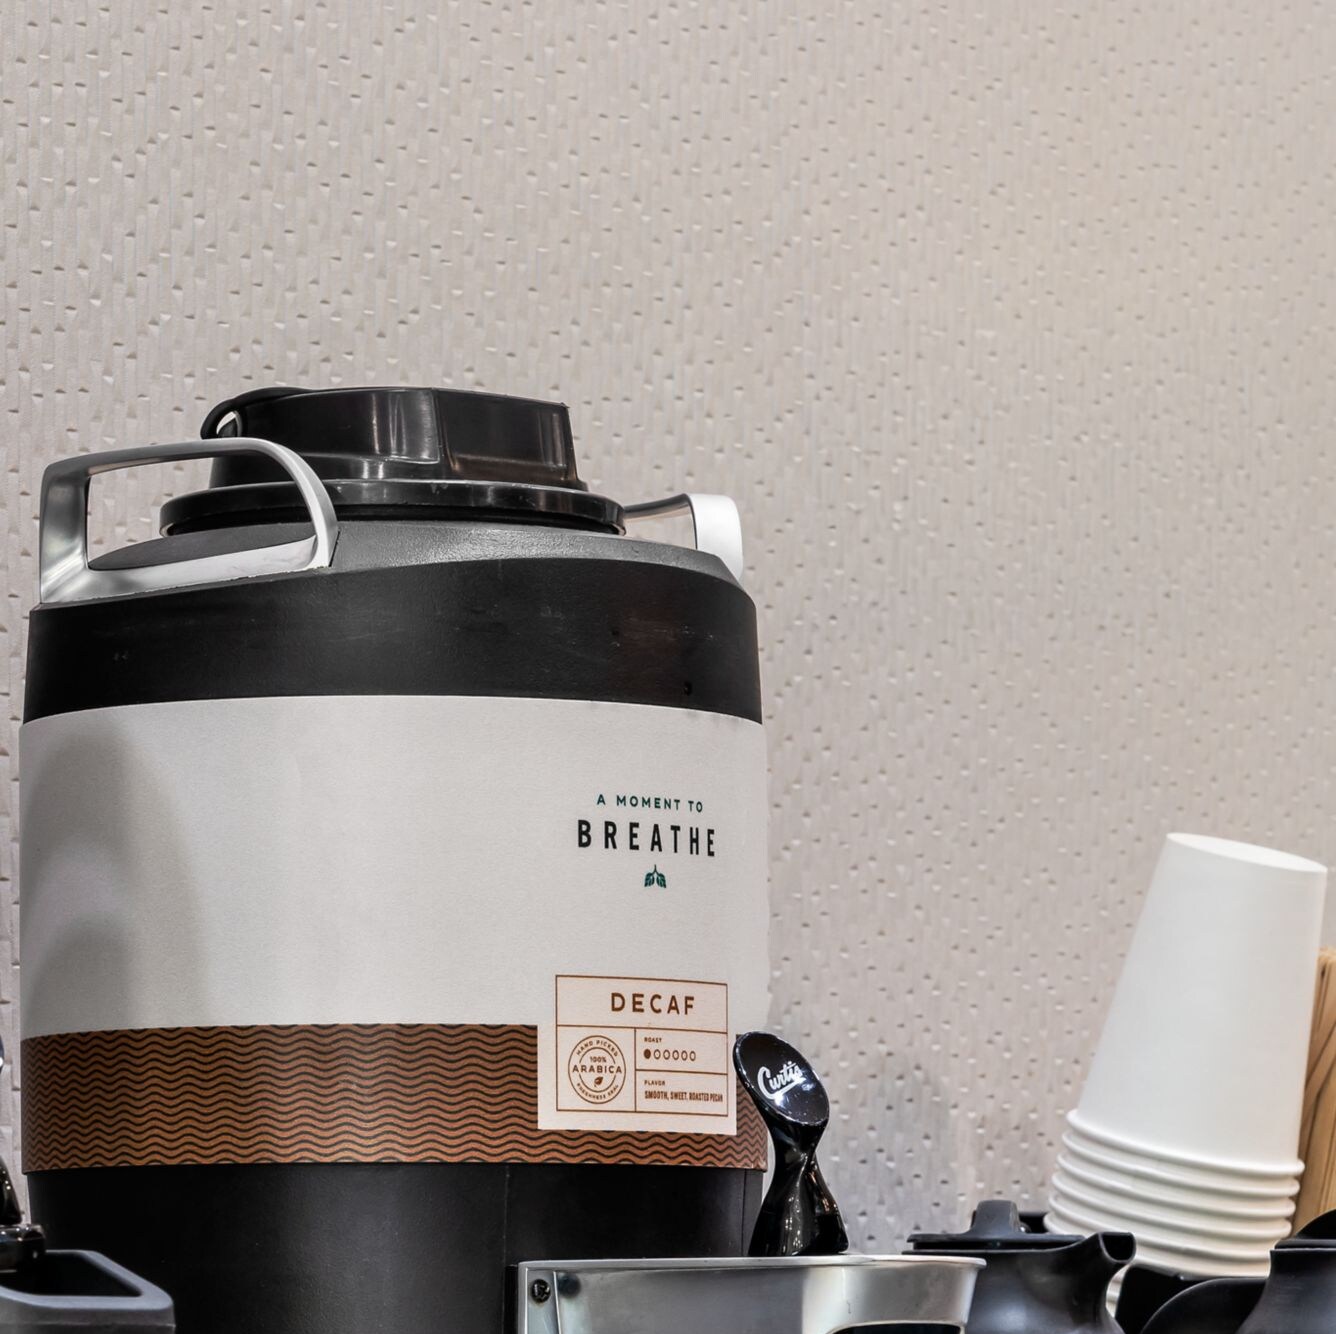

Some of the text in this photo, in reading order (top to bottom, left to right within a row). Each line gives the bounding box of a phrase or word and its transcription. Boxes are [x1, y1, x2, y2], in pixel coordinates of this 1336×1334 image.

[596, 794, 703, 813] A MOMENT TO
[577, 819, 715, 857] BREATHE
[611, 992, 695, 1016] DECAF
[576, 1039, 618, 1057] HAND PICKED
[644, 1036, 662, 1044] ROAST
[572, 1064, 622, 1074] ARABICA
[757, 1061, 806, 1101] Curtis
[644, 1090, 669, 1101] SMOOTH,
